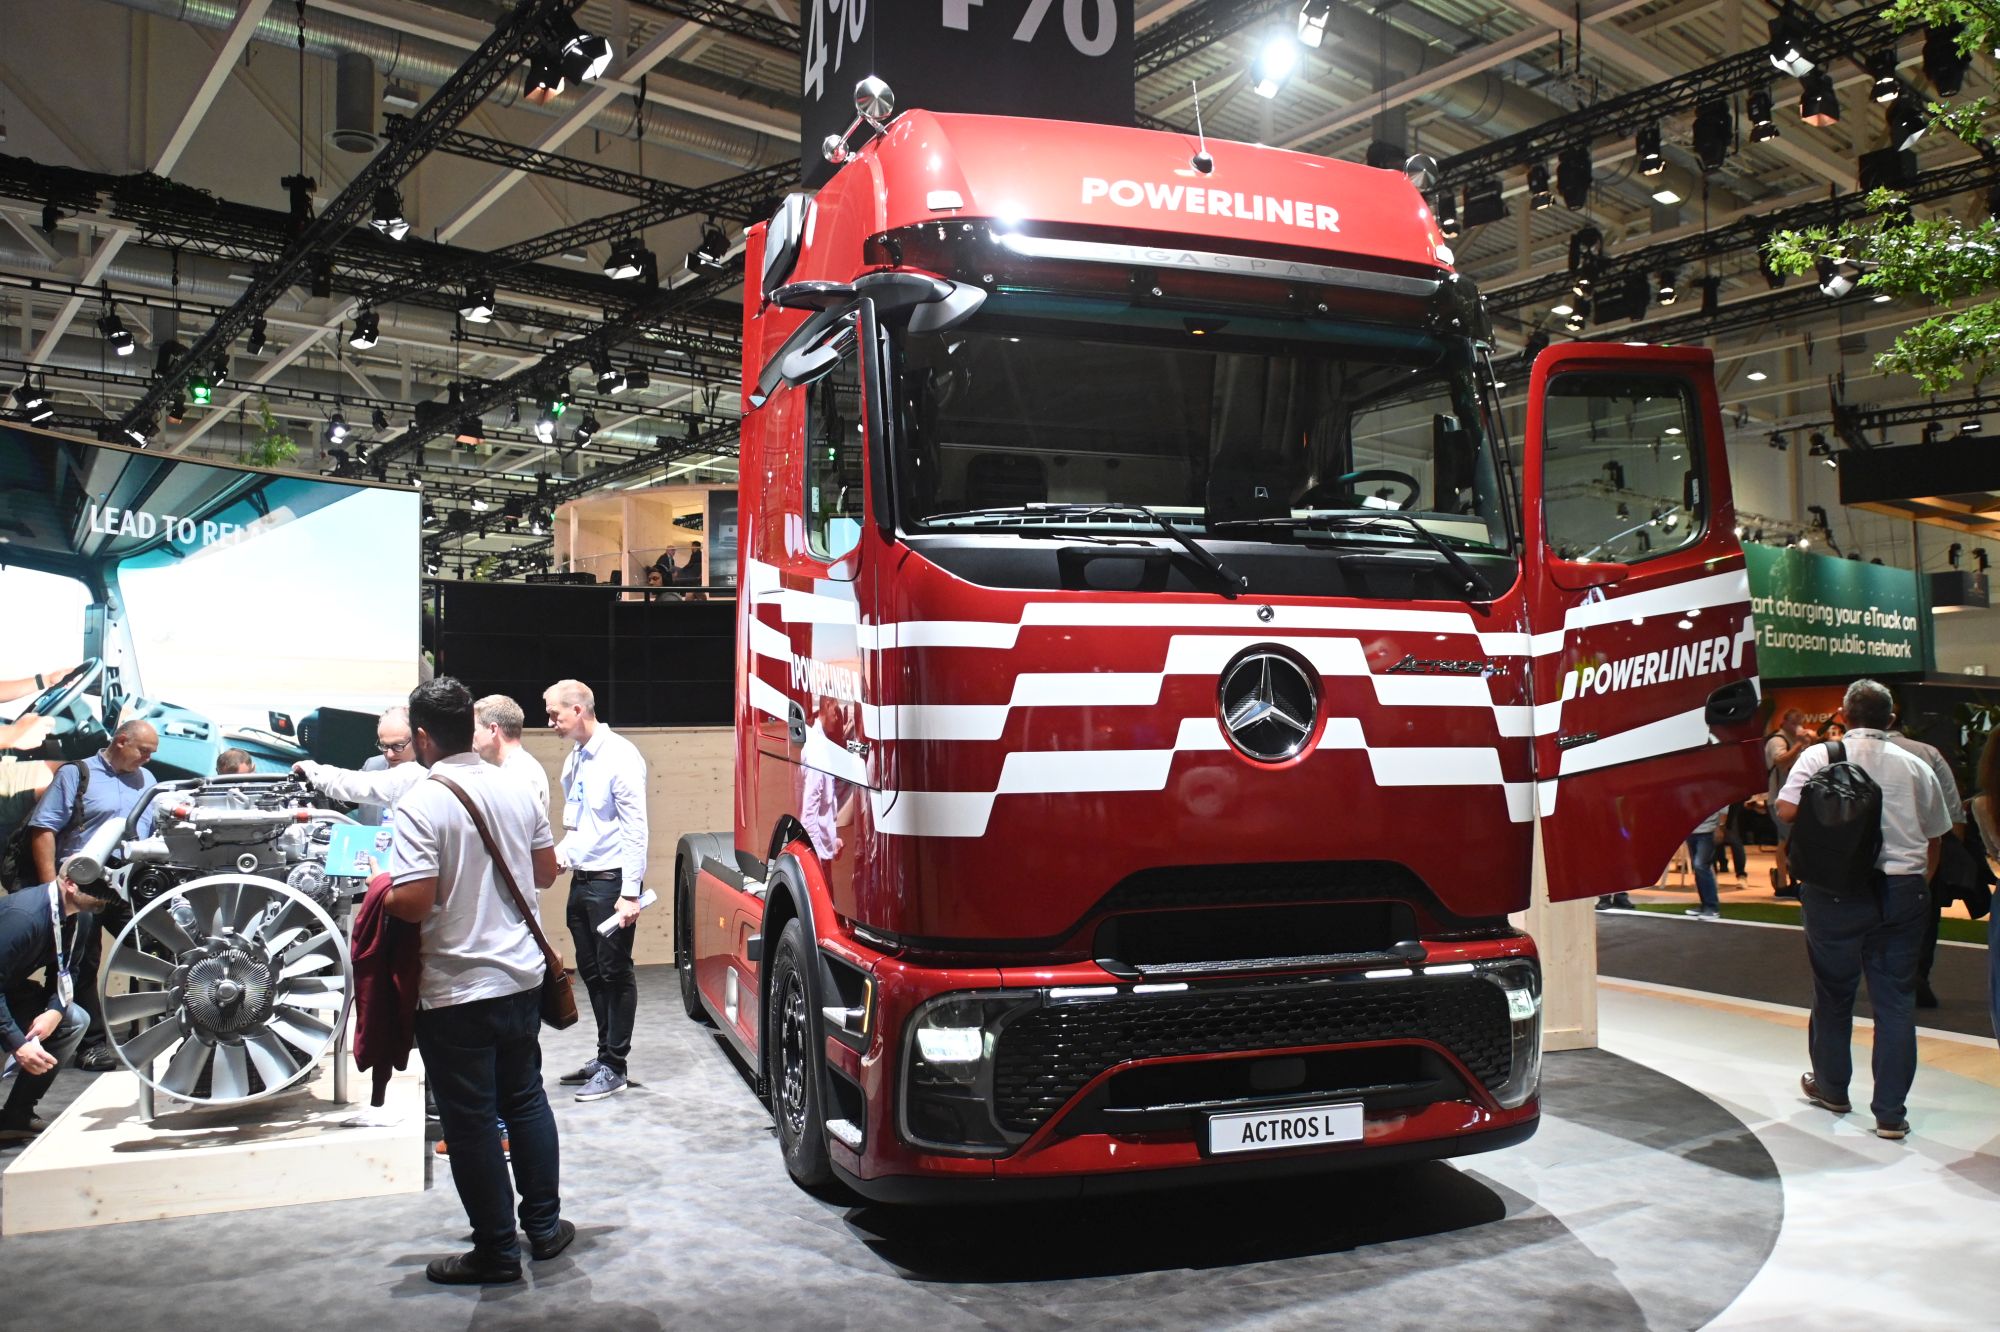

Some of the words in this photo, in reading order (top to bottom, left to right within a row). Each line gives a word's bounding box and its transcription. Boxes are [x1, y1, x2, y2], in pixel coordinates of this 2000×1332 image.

[1081, 177, 1341, 233] POWERLINER
[90, 504, 156, 539] LEAD
[162, 514, 197, 545] TO
[203, 520, 268, 547] REL
[1750, 595, 1774, 616] art
[1775, 595, 1834, 625] charging
[1835, 607, 1863, 628] your
[1864, 606, 1902, 630] eTruck
[1902, 617, 1917, 632] on
[1765, 624, 1828, 654] European
[1829, 633, 1866, 656] public
[1867, 639, 1912, 659] network
[793, 653, 854, 702] POWERLINER
[1579, 635, 1731, 698] POWERLINER
[1241, 1116, 1319, 1143] ACTROS
[1325, 1115, 1335, 1136] L
